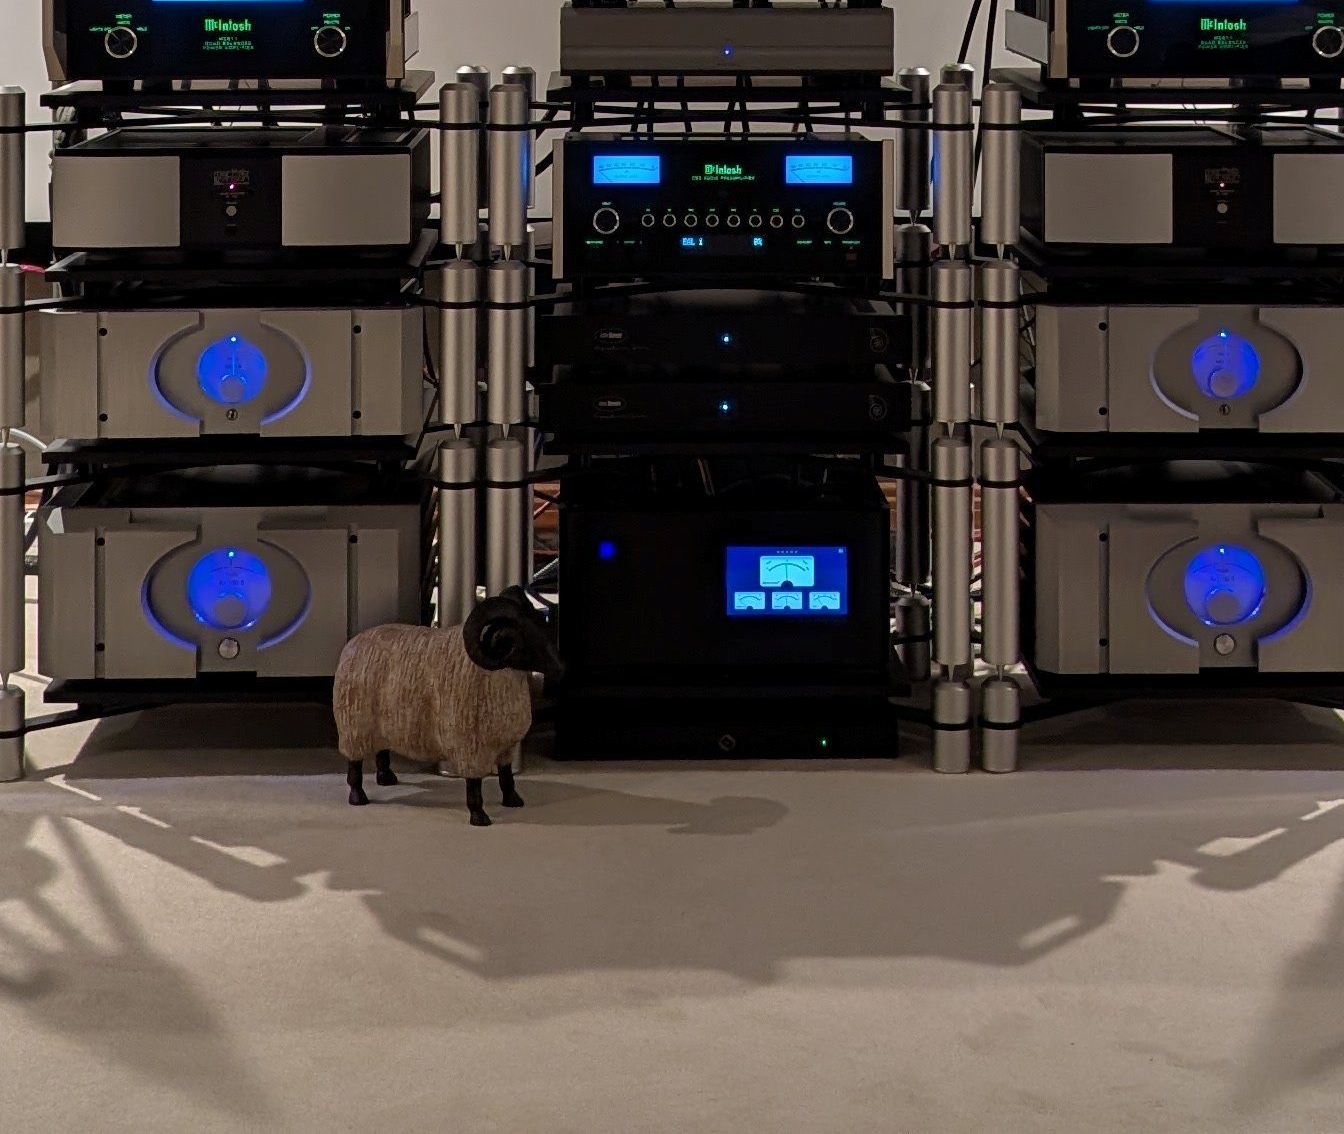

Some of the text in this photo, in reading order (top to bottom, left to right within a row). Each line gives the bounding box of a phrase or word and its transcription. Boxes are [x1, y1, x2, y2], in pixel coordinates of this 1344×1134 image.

[204, 18, 252, 32] McIntosh
[1200, 18, 1247, 31] McIntosh
[704, 164, 742, 175] McIntosh
